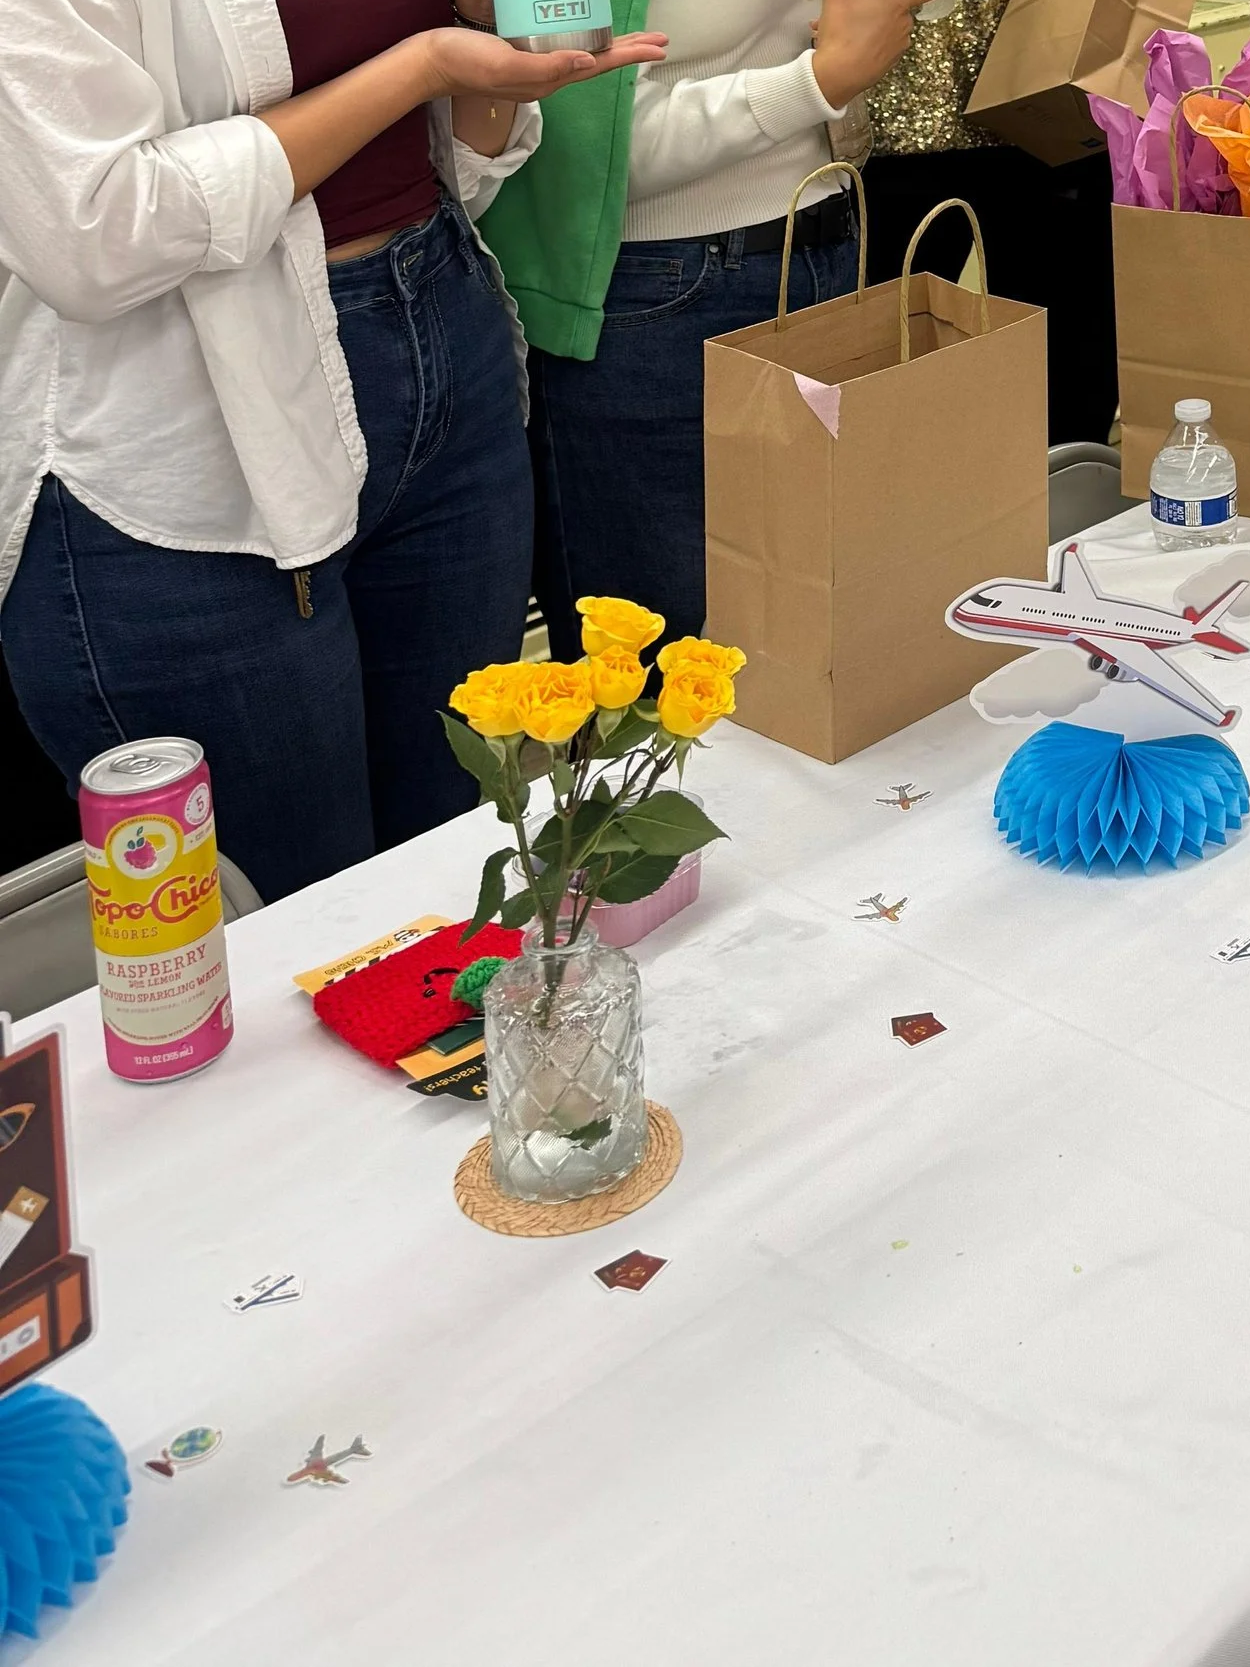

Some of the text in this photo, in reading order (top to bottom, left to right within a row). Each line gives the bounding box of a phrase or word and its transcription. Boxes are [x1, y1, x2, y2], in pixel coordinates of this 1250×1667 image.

[537, 0, 588, 21] YETI
[196, 795, 204, 813] 5
[88, 866, 219, 925] Topo Chico
[107, 943, 207, 979] RASPBERRY
[137, 980, 196, 1003] SPARKLING
[196, 962, 223, 985] WATER
[148, 972, 182, 987] LEMON
[134, 1056, 143, 1065] 12
[426, 1065, 481, 1092] teachers!
